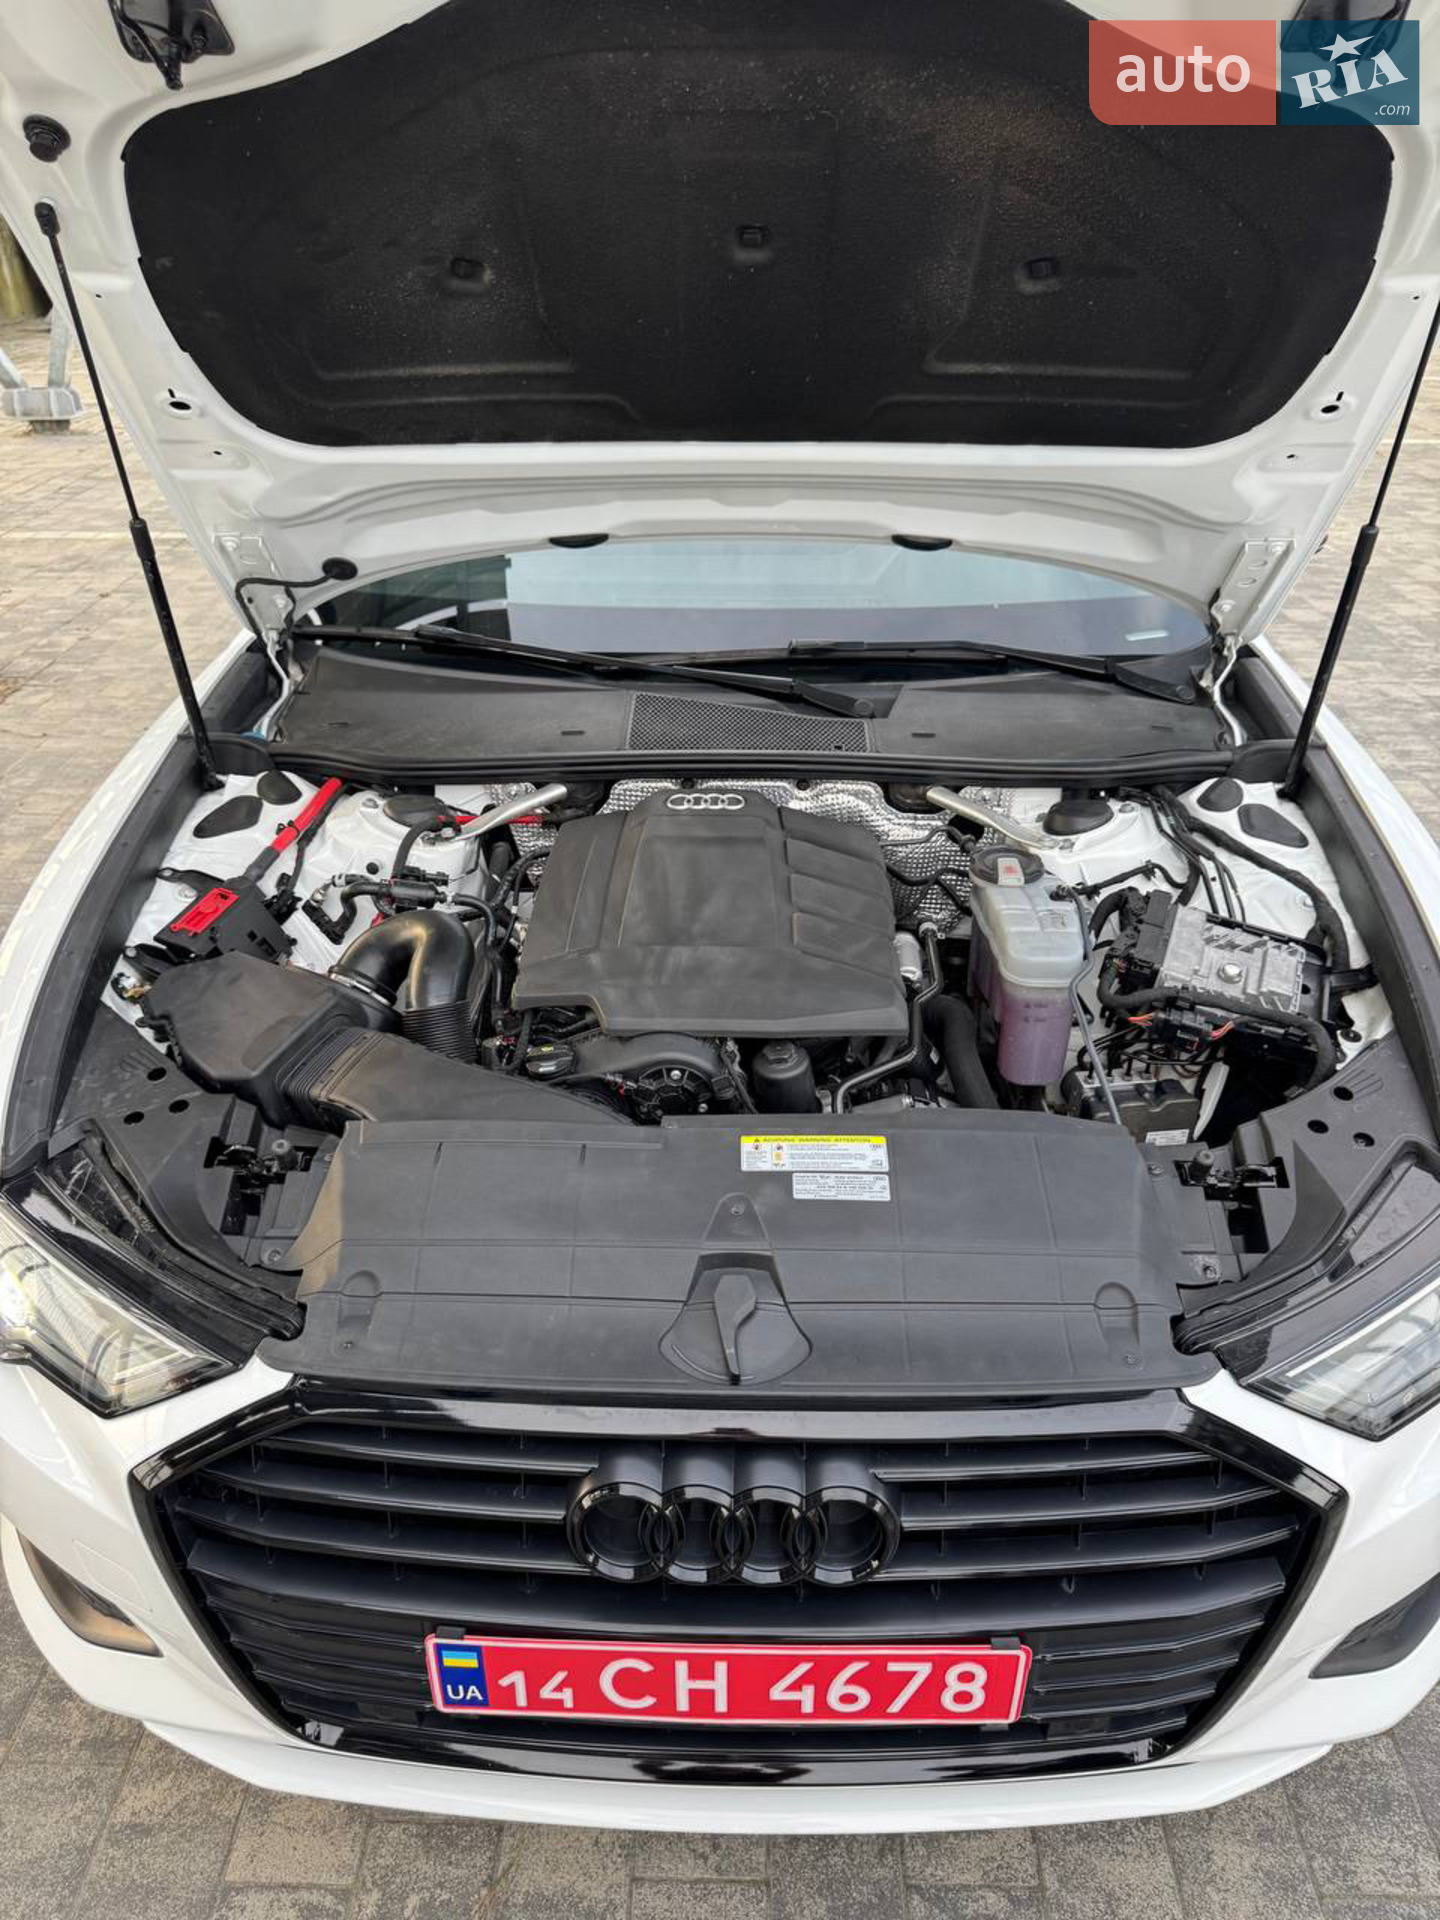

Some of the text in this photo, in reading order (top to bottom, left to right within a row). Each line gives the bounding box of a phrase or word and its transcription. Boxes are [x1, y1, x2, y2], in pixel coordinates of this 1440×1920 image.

[447, 1684, 484, 1701] UA
[497, 1658, 988, 1714] 14 CH 4678
